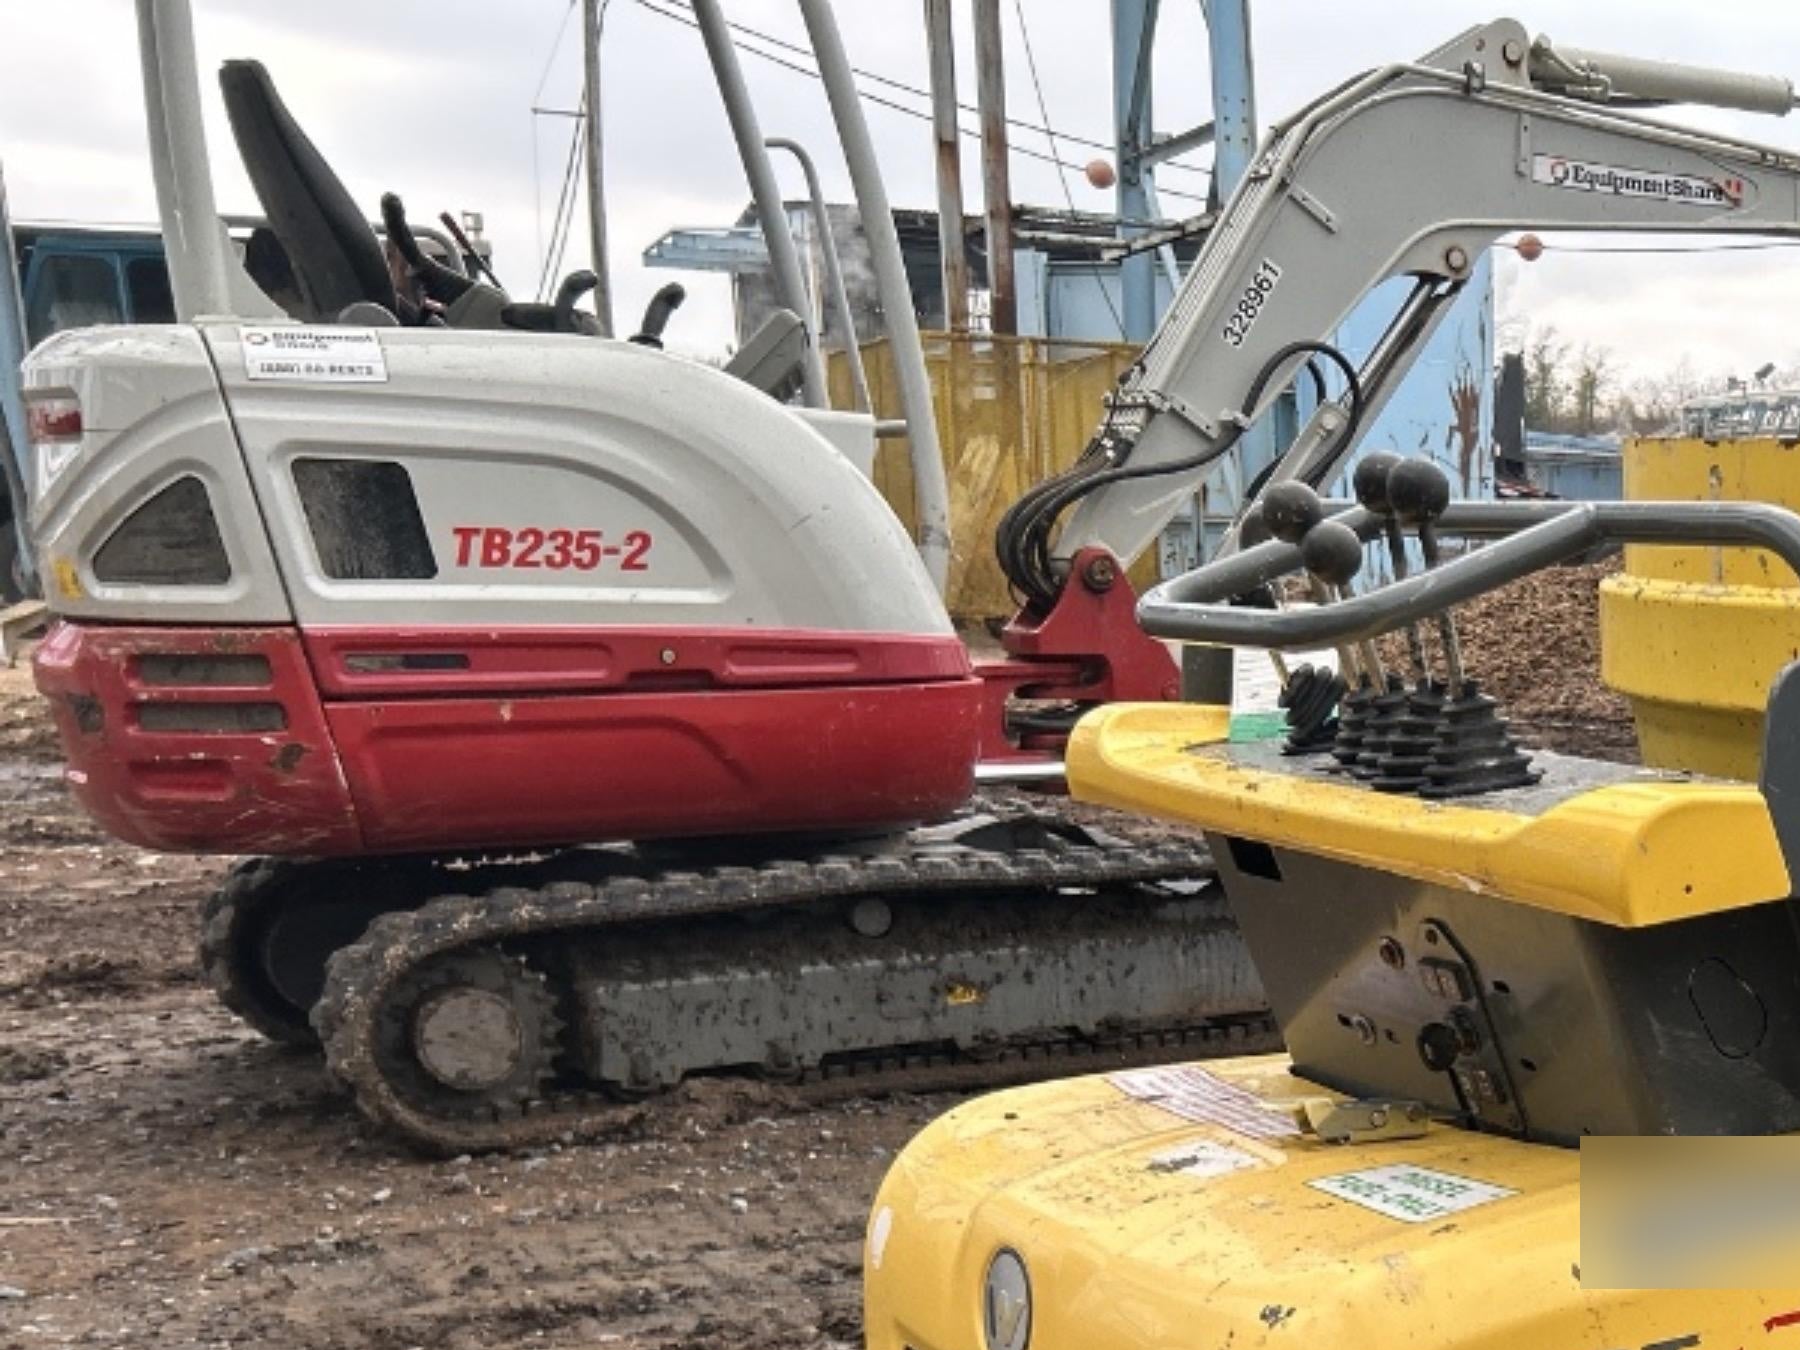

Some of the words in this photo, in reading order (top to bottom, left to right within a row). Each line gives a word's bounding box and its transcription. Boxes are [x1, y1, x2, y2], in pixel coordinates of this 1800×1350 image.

[1572, 163, 1724, 202] EquipmentShare
[1223, 261, 1279, 346] 328961
[452, 527, 653, 571] TB235-2
